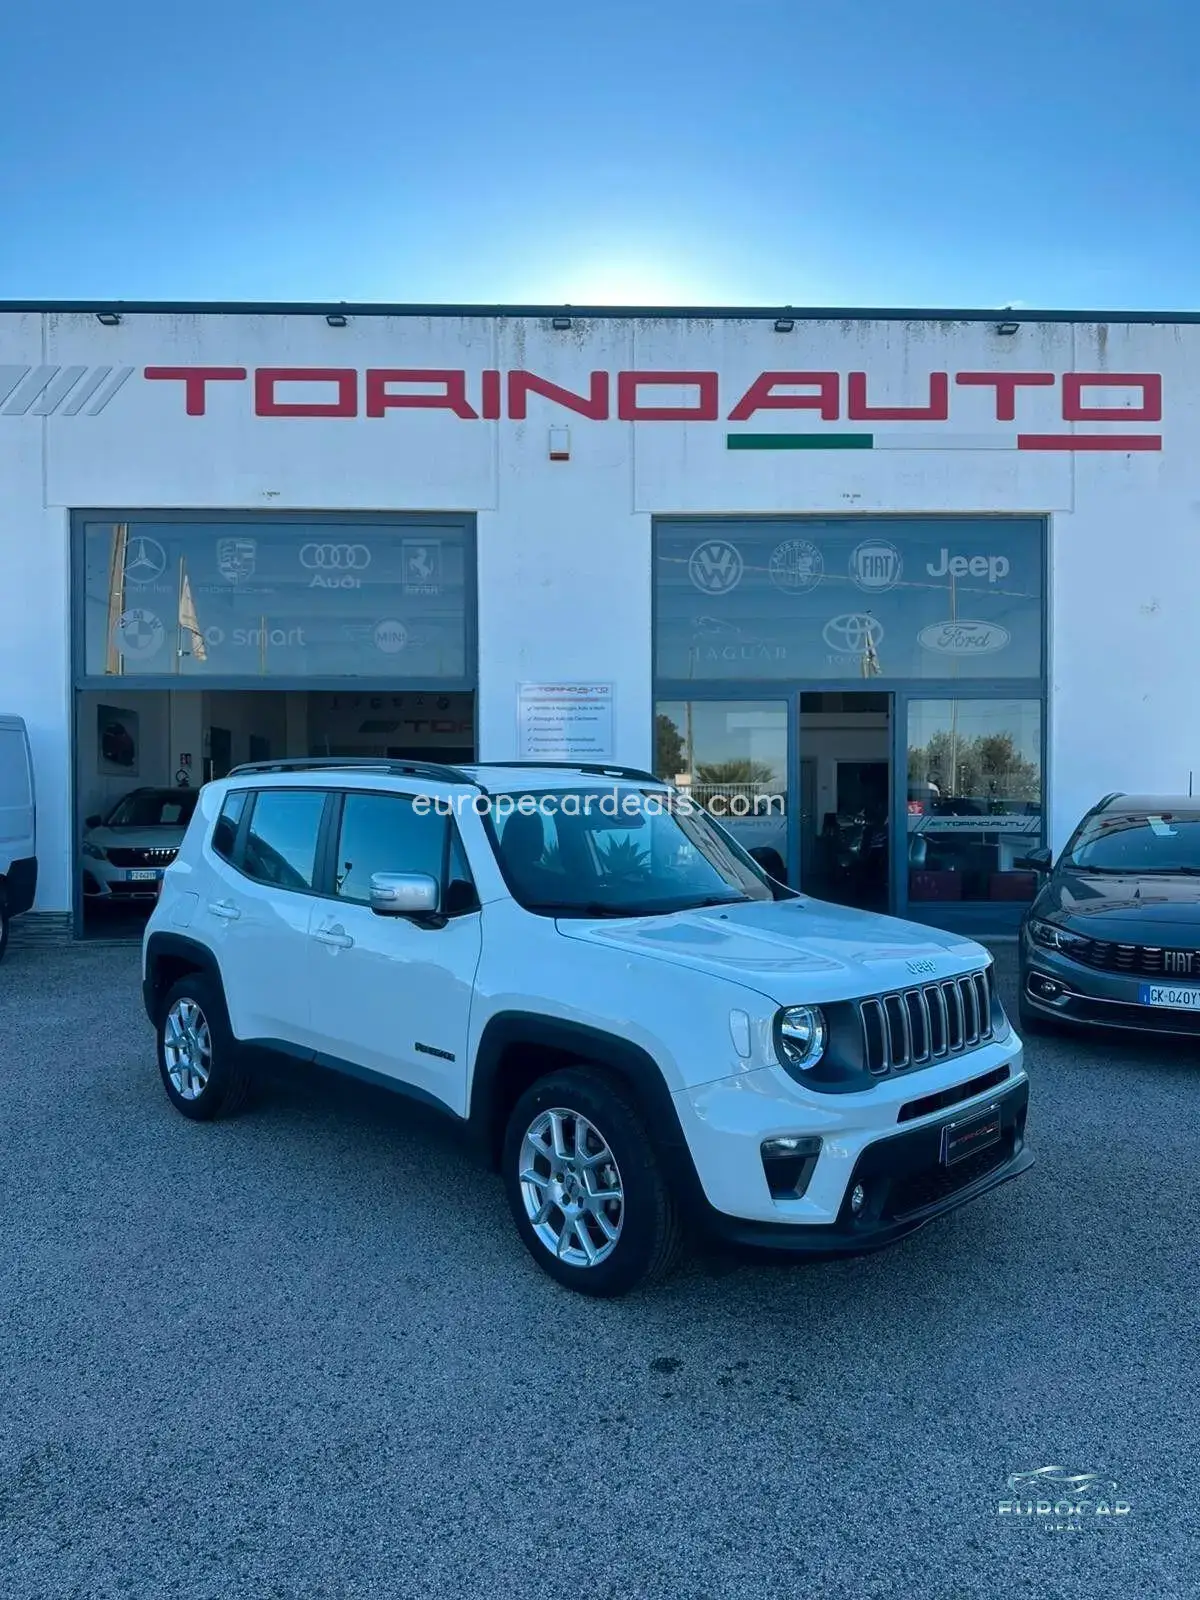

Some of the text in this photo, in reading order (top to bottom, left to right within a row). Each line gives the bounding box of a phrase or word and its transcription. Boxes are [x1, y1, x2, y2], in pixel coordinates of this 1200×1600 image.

[144, 367, 1162, 421] TORINOAUTO
[862, 555, 892, 578] FIAT
[926, 548, 1010, 583] Jeep
[309, 574, 361, 588] Audi
[232, 626, 306, 646] smart
[376, 631, 404, 643] MINI
[937, 626, 991, 648] Ford
[1164, 951, 1195, 973] FIAT
